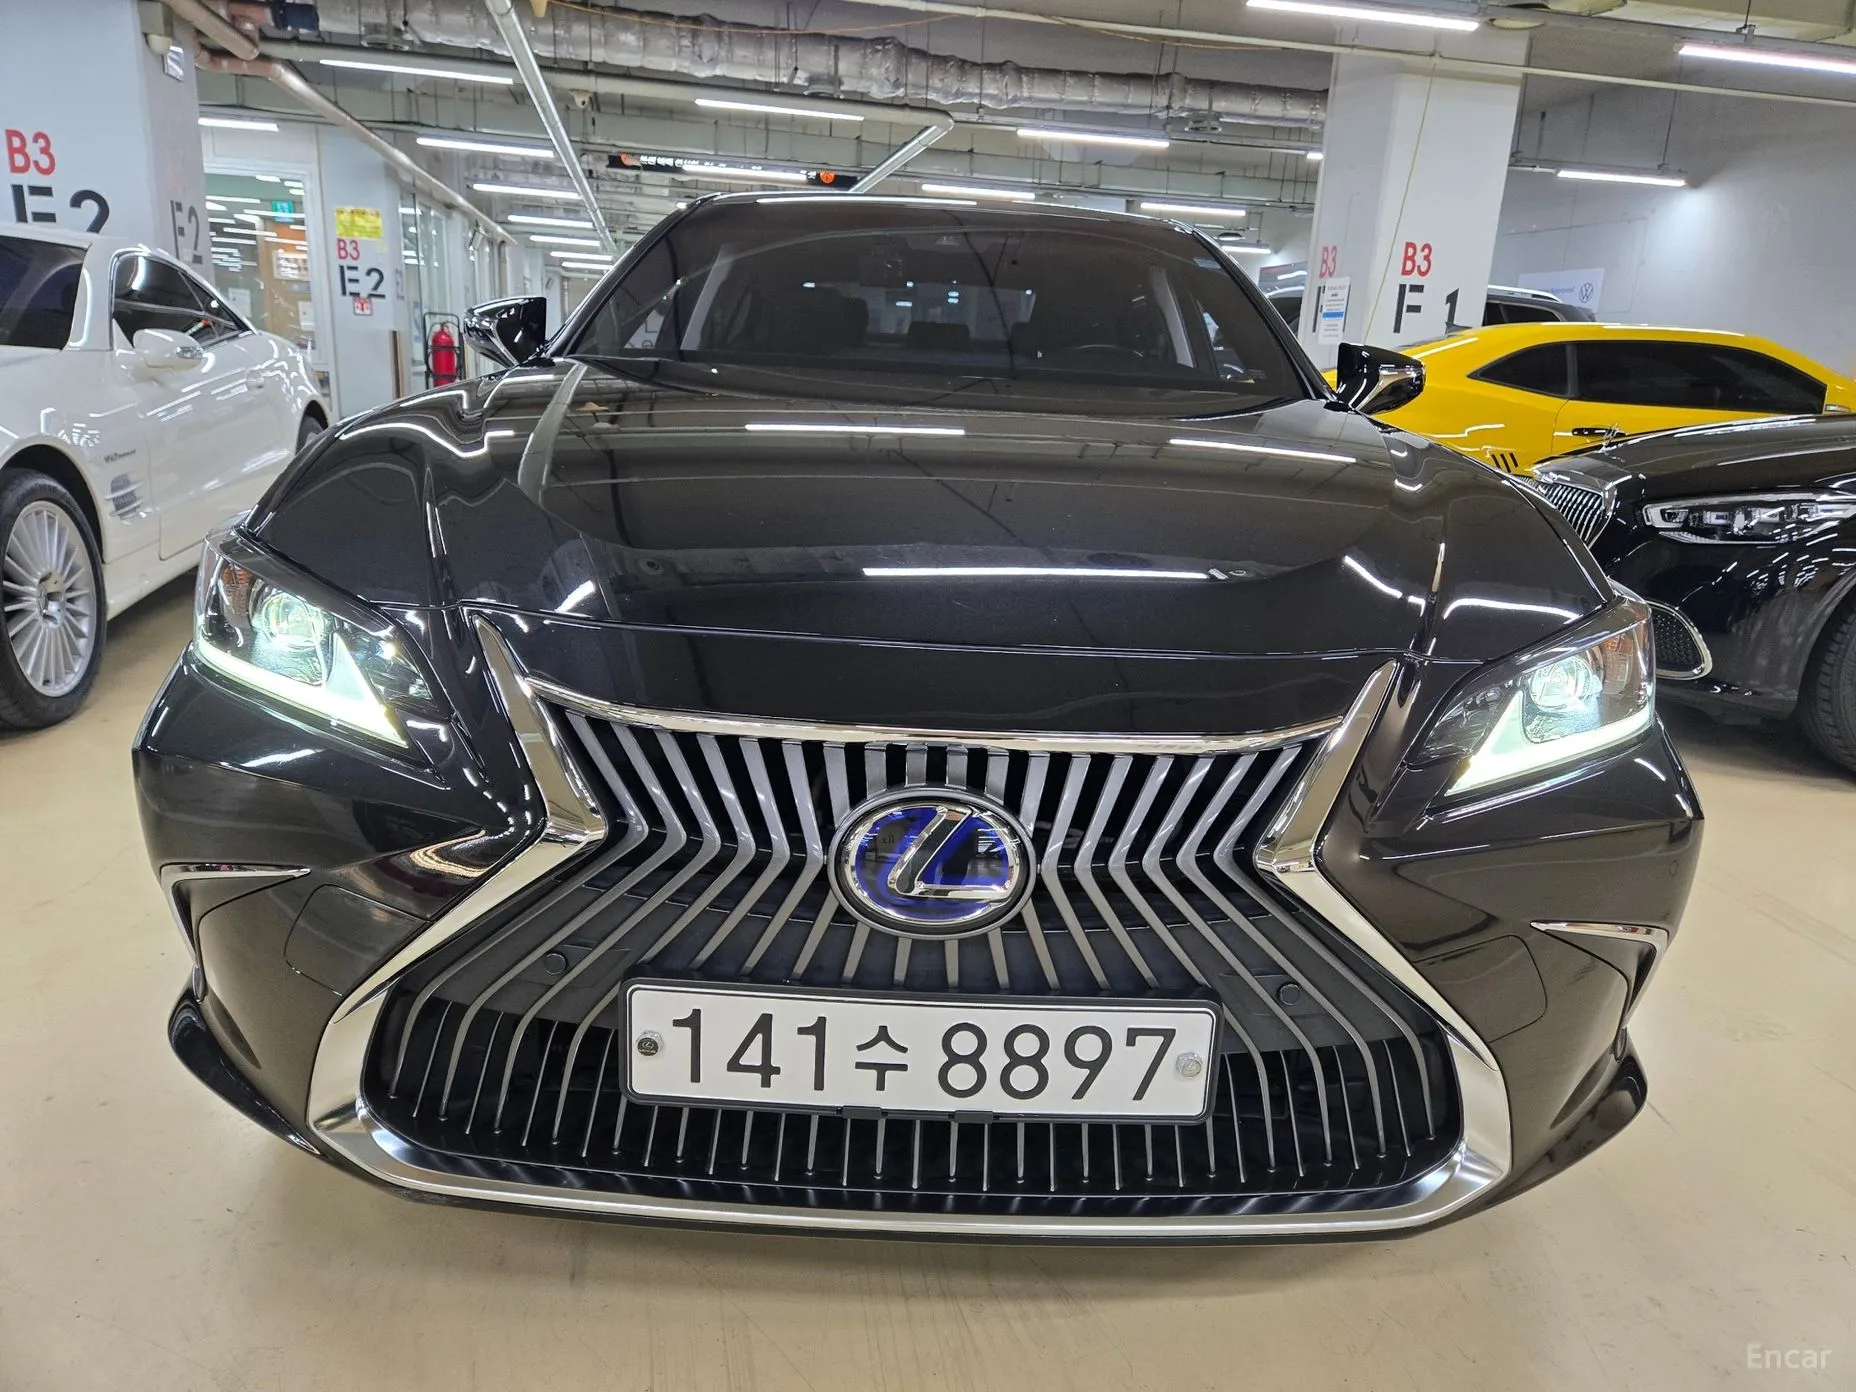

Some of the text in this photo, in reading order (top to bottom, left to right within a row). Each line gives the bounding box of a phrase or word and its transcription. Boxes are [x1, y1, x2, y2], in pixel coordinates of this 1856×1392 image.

[5, 129, 56, 176] B3
[337, 239, 360, 260] B3
[1319, 246, 1338, 278] B3
[1401, 242, 1433, 277] B3
[339, 265, 386, 299] E2
[1393, 284, 1460, 333] F1
